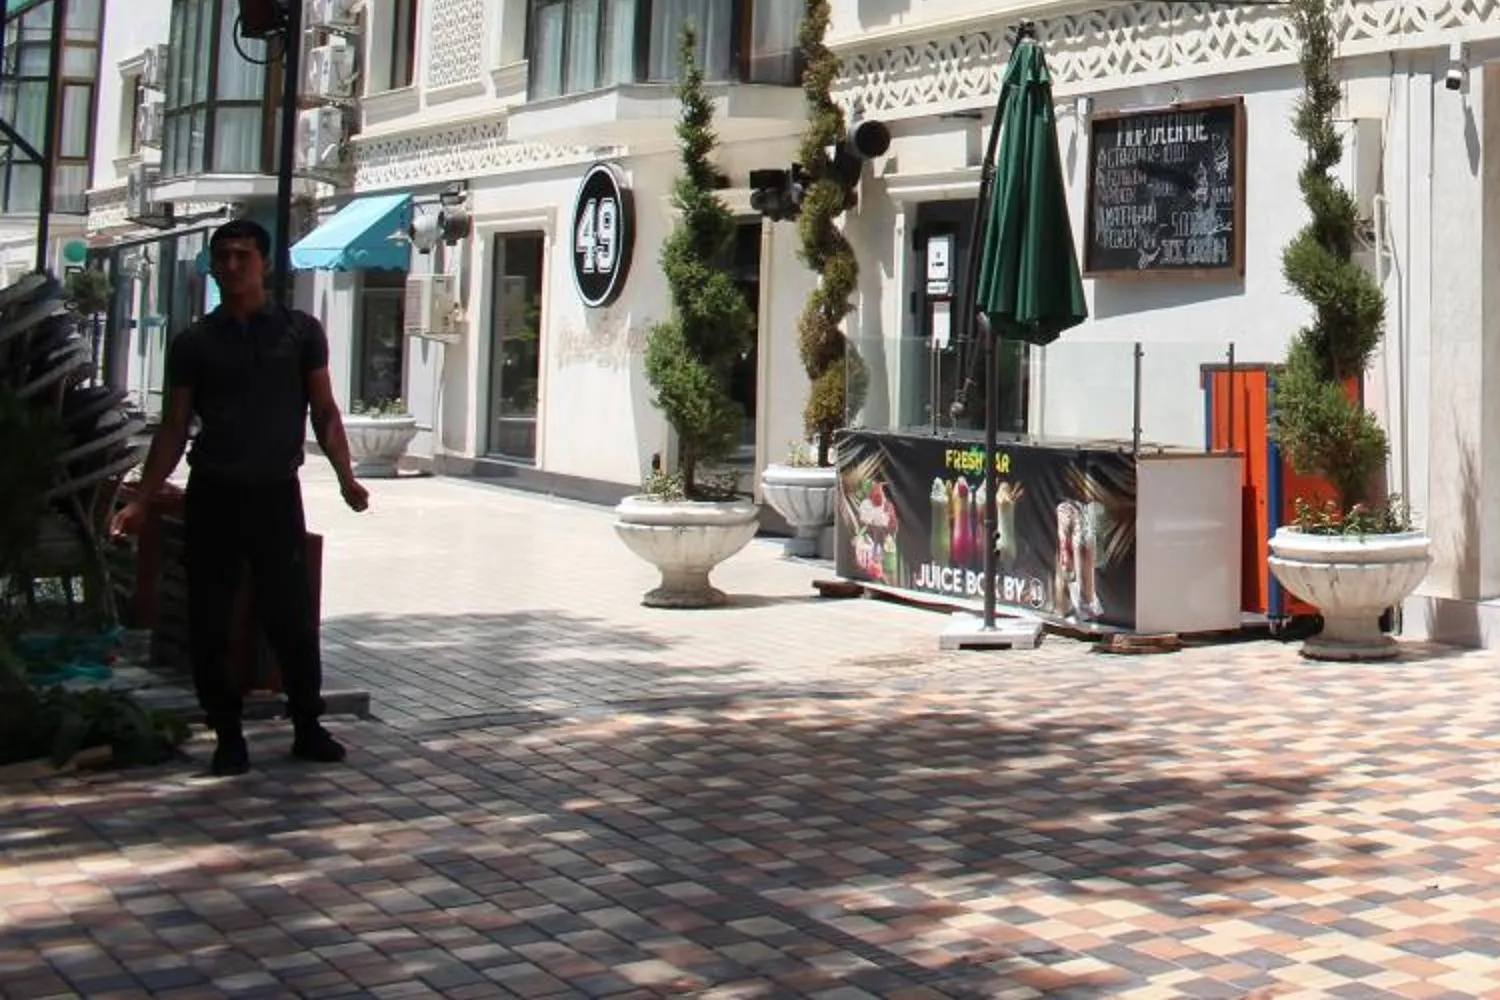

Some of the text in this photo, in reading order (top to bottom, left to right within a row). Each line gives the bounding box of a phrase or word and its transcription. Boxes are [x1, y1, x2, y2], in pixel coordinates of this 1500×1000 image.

[576, 198, 617, 274] 49
[945, 449, 983, 472] FRESH
[914, 560, 962, 593] JUICE
[1003, 575, 1025, 603] BY
